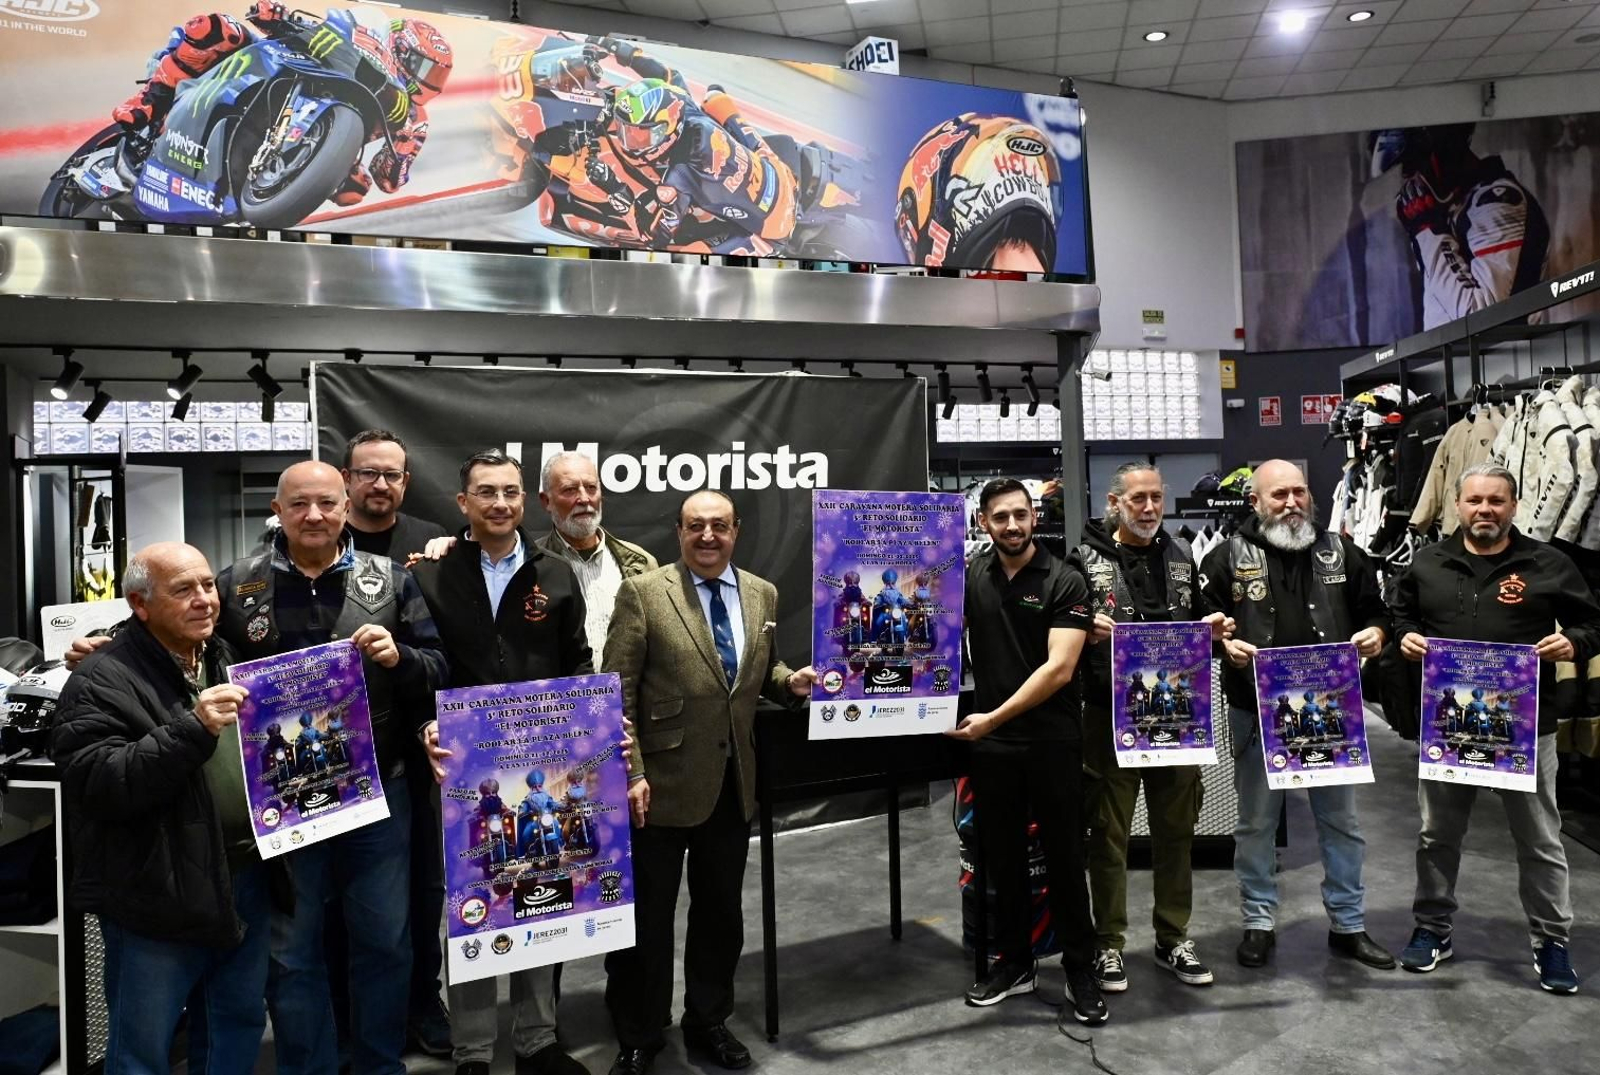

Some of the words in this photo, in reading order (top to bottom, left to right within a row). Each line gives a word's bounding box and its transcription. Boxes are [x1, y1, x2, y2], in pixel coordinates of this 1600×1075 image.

[11, 21, 23, 29] IN
[24, 22, 45, 32] THE
[47, 25, 87, 37] WORLD
[165, 128, 210, 165] MONSTR
[1010, 140, 1042, 153] HJC
[993, 151, 1043, 187] HELL
[138, 185, 170, 212] YAMAHA
[839, 502, 883, 511] CARAVANA
[920, 504, 960, 512] SOLIDARIA
[864, 686, 873, 694] el
[874, 684, 911, 694] Motorista
[443, 702, 464, 711] XXII
[469, 697, 522, 709] CARAVANA
[525, 692, 563, 703] MOTERA
[566, 687, 614, 698] SOLIDARIA
[499, 708, 523, 718] RETO
[526, 702, 576, 715] SOLIDARIO
[513, 715, 572, 729] MOTORISTA"
[532, 733, 561, 743] PLAZA
[494, 752, 530, 763] DOMINGO
[541, 756, 567, 766] HORAS
[515, 909, 525, 919] el
[526, 900, 573, 917] Motorista
